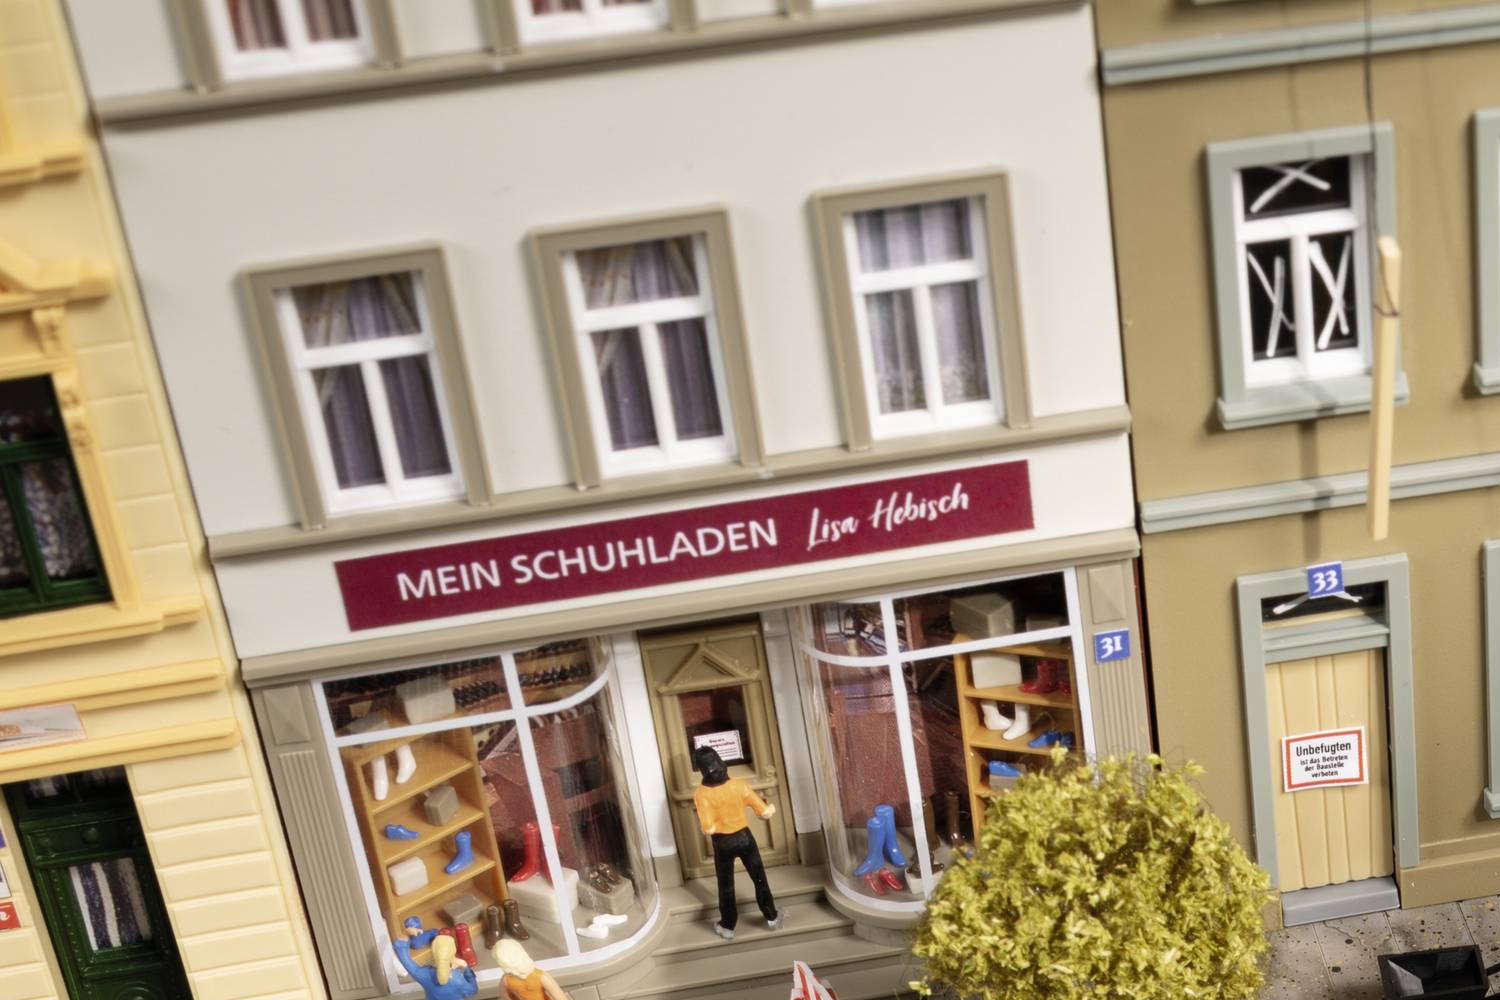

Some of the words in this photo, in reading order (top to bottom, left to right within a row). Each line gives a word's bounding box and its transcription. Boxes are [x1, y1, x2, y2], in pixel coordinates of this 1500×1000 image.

[397, 559, 501, 600] MEIN
[510, 518, 778, 583] SCHUHLADEN
[806, 507, 859, 551] Lisa
[867, 481, 969, 532] Hebisch
[1312, 570, 1338, 594] 33
[1100, 635, 1123, 659] 31
[1295, 741, 1351, 757] Unbefugten
[1300, 758, 1308, 766] ist
[1322, 754, 1348, 762] Betreten
[1316, 761, 1344, 770] Baustelle
[1311, 770, 1338, 778] verboten
